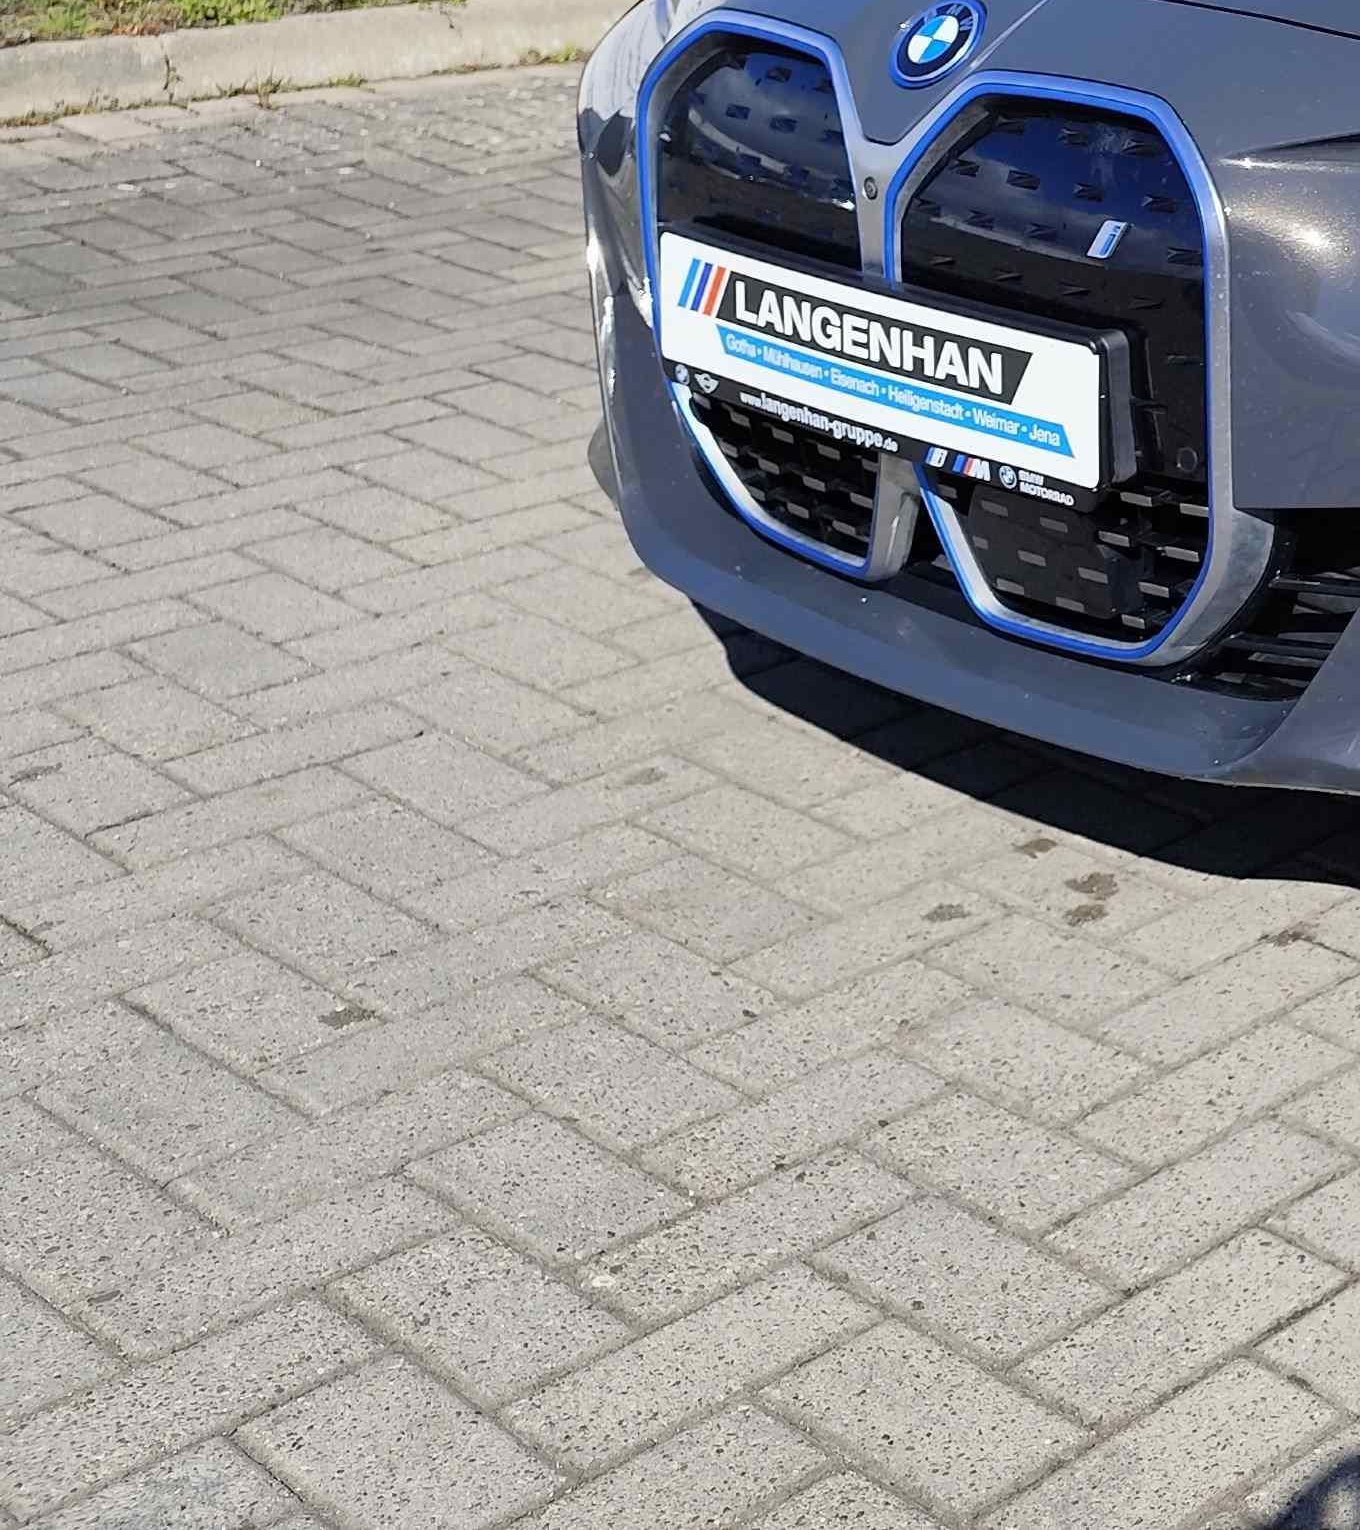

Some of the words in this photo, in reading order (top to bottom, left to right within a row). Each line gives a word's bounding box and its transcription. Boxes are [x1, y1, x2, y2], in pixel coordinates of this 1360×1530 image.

[734, 280, 1004, 396] LANGENHAN
[739, 392, 899, 453] www.langenhan-gruppe.de
[830, 368, 880, 397] Eisenach
[887, 384, 965, 421] Heiligenstadt
[972, 407, 1021, 435] Weimar
[1028, 423, 1061, 447] Jena
[1019, 481, 1076, 507] MOTORRAD
